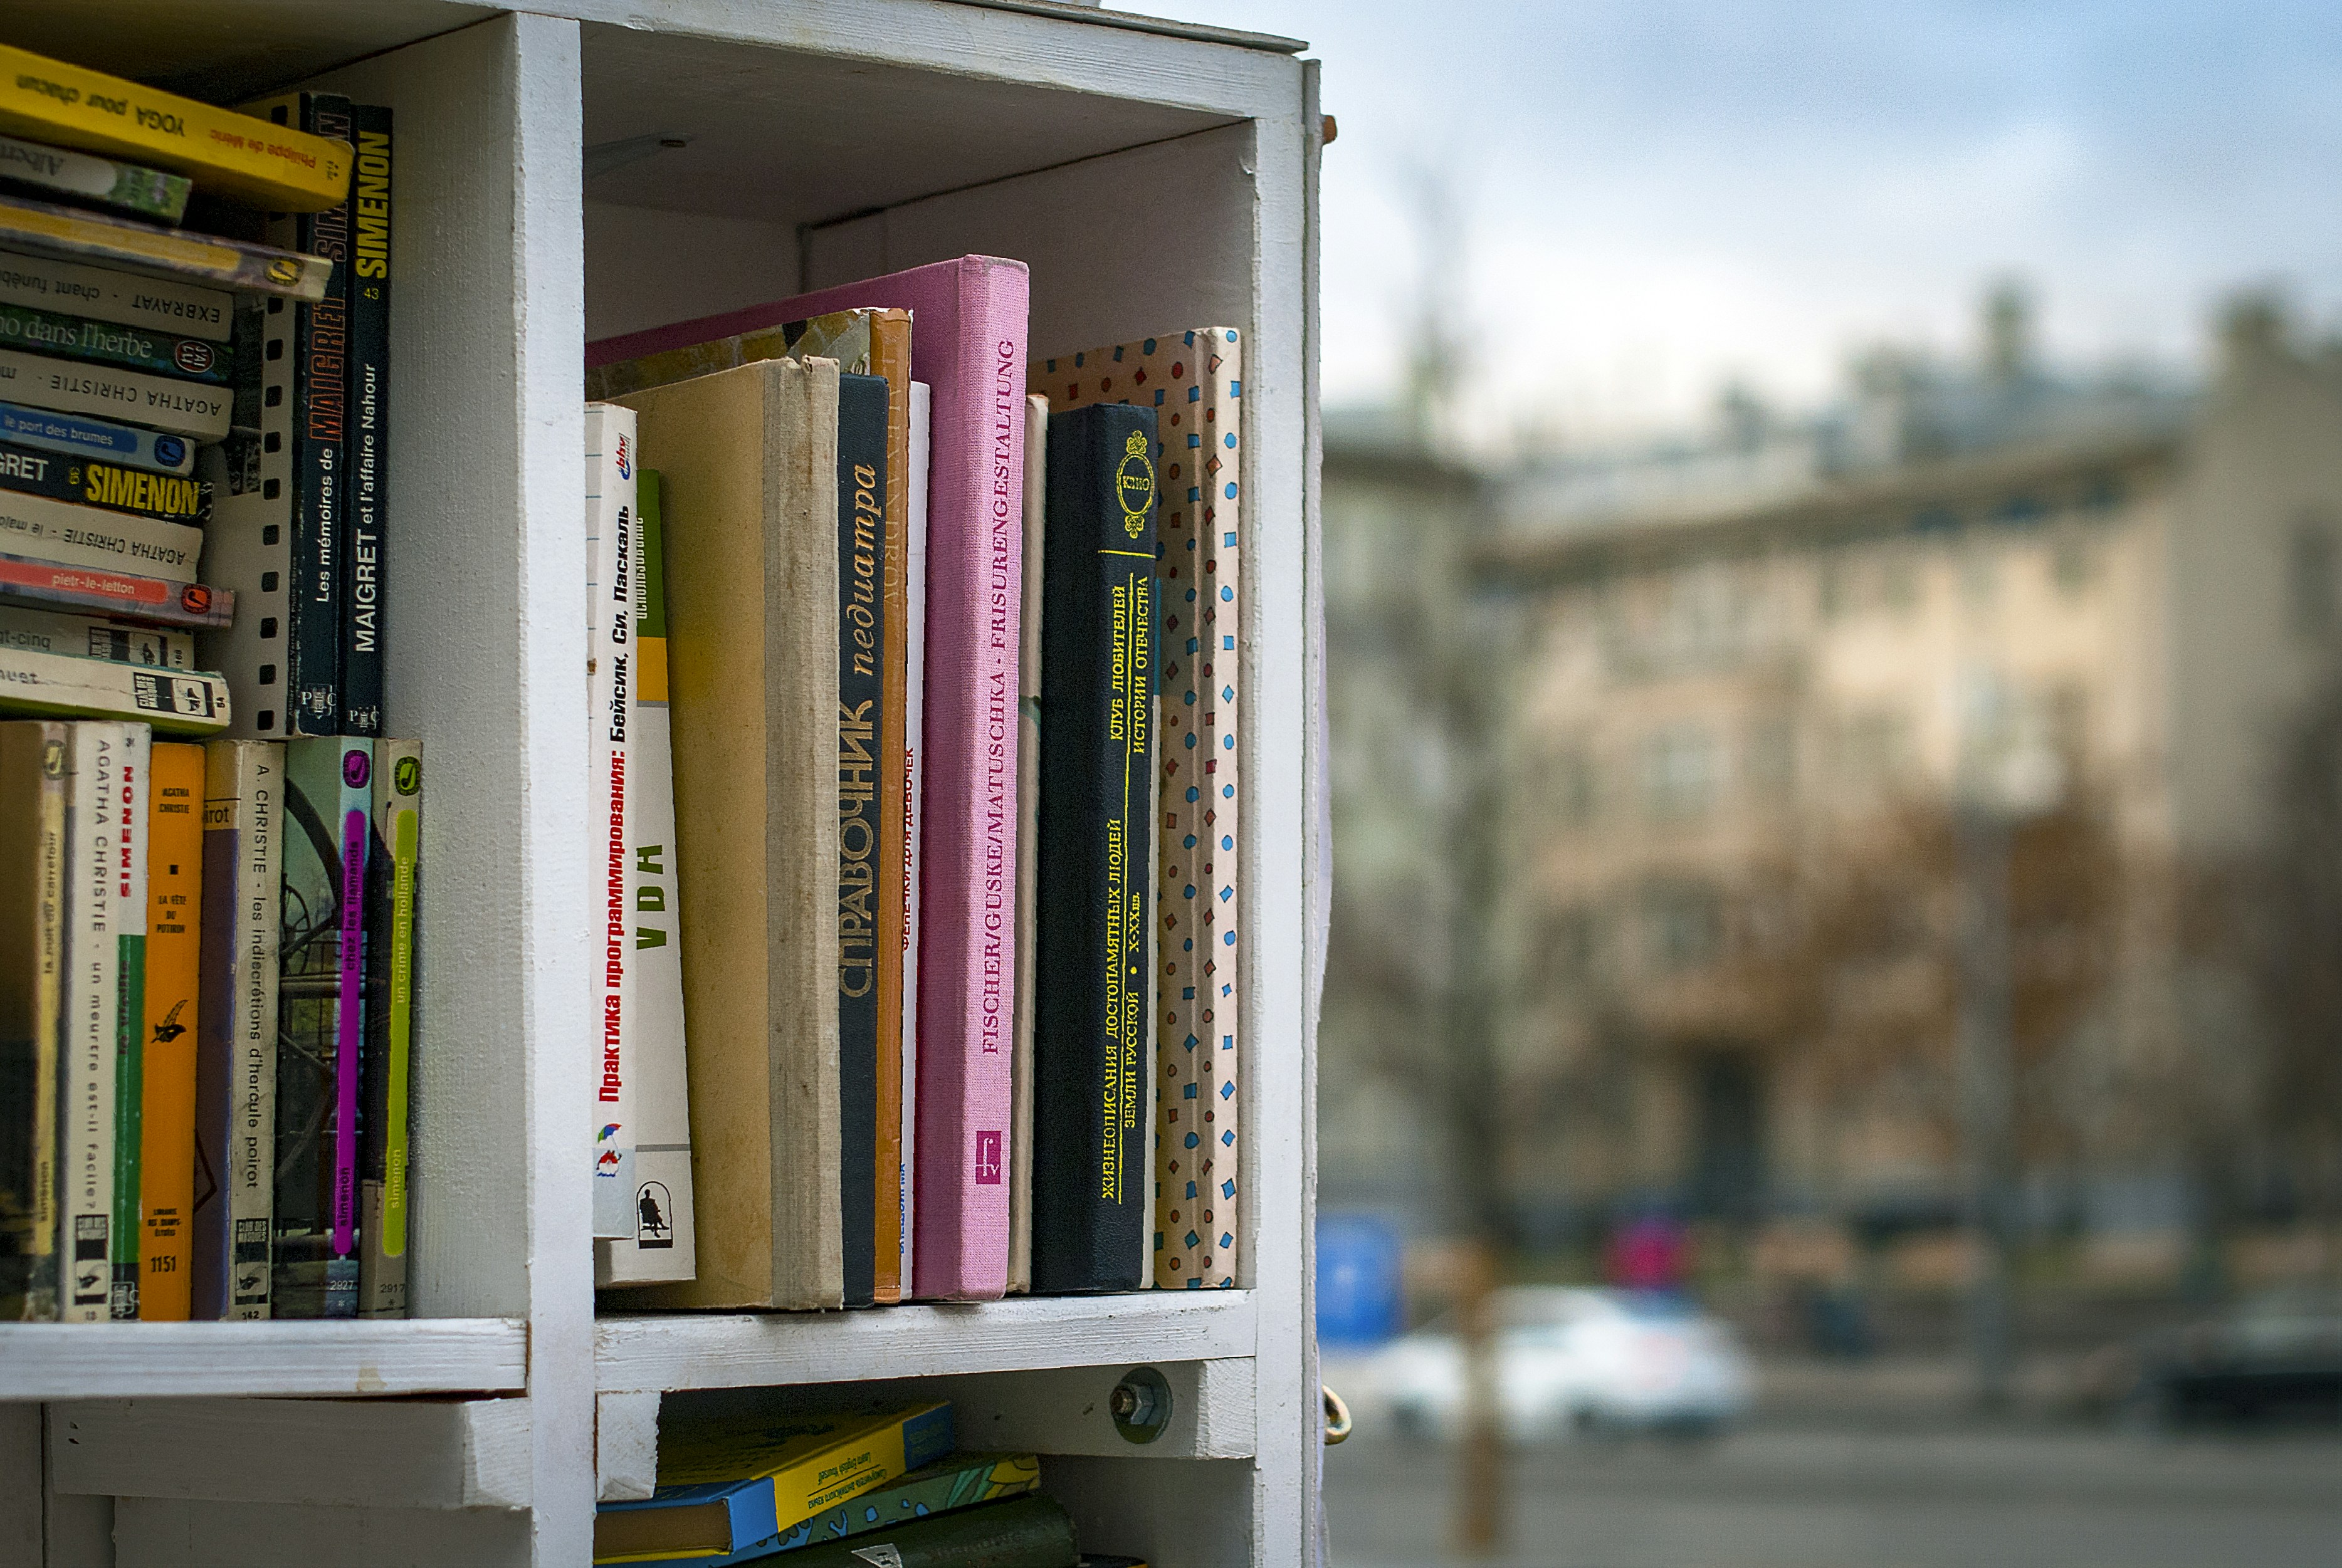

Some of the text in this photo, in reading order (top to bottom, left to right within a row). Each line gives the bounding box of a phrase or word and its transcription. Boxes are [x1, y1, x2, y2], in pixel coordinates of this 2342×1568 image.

[16, 75, 186, 137] YOGA pour chacun
[248, 139, 264, 154] de
[266, 144, 317, 169] Philippe
[355, 131, 389, 280] SIMENON
[55, 282, 100, 300] chant
[364, 289, 379, 300] 43
[132, 295, 220, 323] EXBRAYAT
[26, 315, 76, 346] dans
[82, 323, 152, 358] l'herbe
[181, 345, 194, 364] LU
[194, 346, 207, 367] J'AI
[50, 375, 137, 402] CHRISTIE
[147, 390, 221, 417] AGATHA
[18, 419, 43, 434] port
[46, 422, 67, 438] des
[70, 427, 113, 446] brumes
[322, 448, 333, 472] de
[85, 464, 201, 516] SIMENON
[318, 476, 332, 565] mémoires
[355, 364, 377, 652] MAIGRET et l'affaire Nahour
[31, 523, 43, 536] le
[65, 528, 125, 555] CHRISTIE
[131, 543, 186, 566] AGATHA
[52, 573, 135, 596] pietr-le-letton
[316, 572, 330, 602] Les
[1110, 585, 1127, 741] КЛУБ ЛЮБИТЕЛЕЙ
[1132, 577, 1148, 754] ИСТОРИИ ОТЕЧЕСТВА
[982, 338, 1014, 1056] FISCHER/GUSKE/MATUSCHKA FRISURENGESTALTUNG
[839, 464, 881, 998] СПРАВОЧНИК педиатра
[96, 740, 111, 825] AGATHA
[162, 788, 189, 797] AGATHA
[158, 803, 189, 813] CHRISTIE
[204, 805, 229, 823] irot
[599, 504, 629, 1102] Практика программирования: Бейсик, Си, Паскаль
[120, 766, 134, 897] SIMENON
[92, 836, 108, 933] CHRISTIE
[159, 895, 167, 905] LA
[157, 924, 186, 933] POTIRON
[166, 911, 176, 920] DU
[347, 906, 357, 931] les
[397, 856, 409, 1003] un crime en hollande
[345, 939, 356, 971] chez
[92, 962, 101, 985] un
[246, 763, 270, 1189] A. CHRISTIE les indiscrétions d'hercule poirot
[1101, 819, 1122, 1198] ЖИЗНЕОПИСАНИЯ ДОСТОПАМЯТНЫХ ЛЮДЕЙ
[89, 997, 100, 1071] meurtre
[1125, 991, 1141, 1066] РУССКОЙ
[88, 1081, 99, 1133] est-il
[1125, 1071, 1138, 1128] ЗЕМЛИ
[87, 1141, 99, 1196] facile
[390, 1148, 402, 1209] simenon
[339, 1166, 350, 1227] simenon
[150, 1255, 177, 1273] 1151
